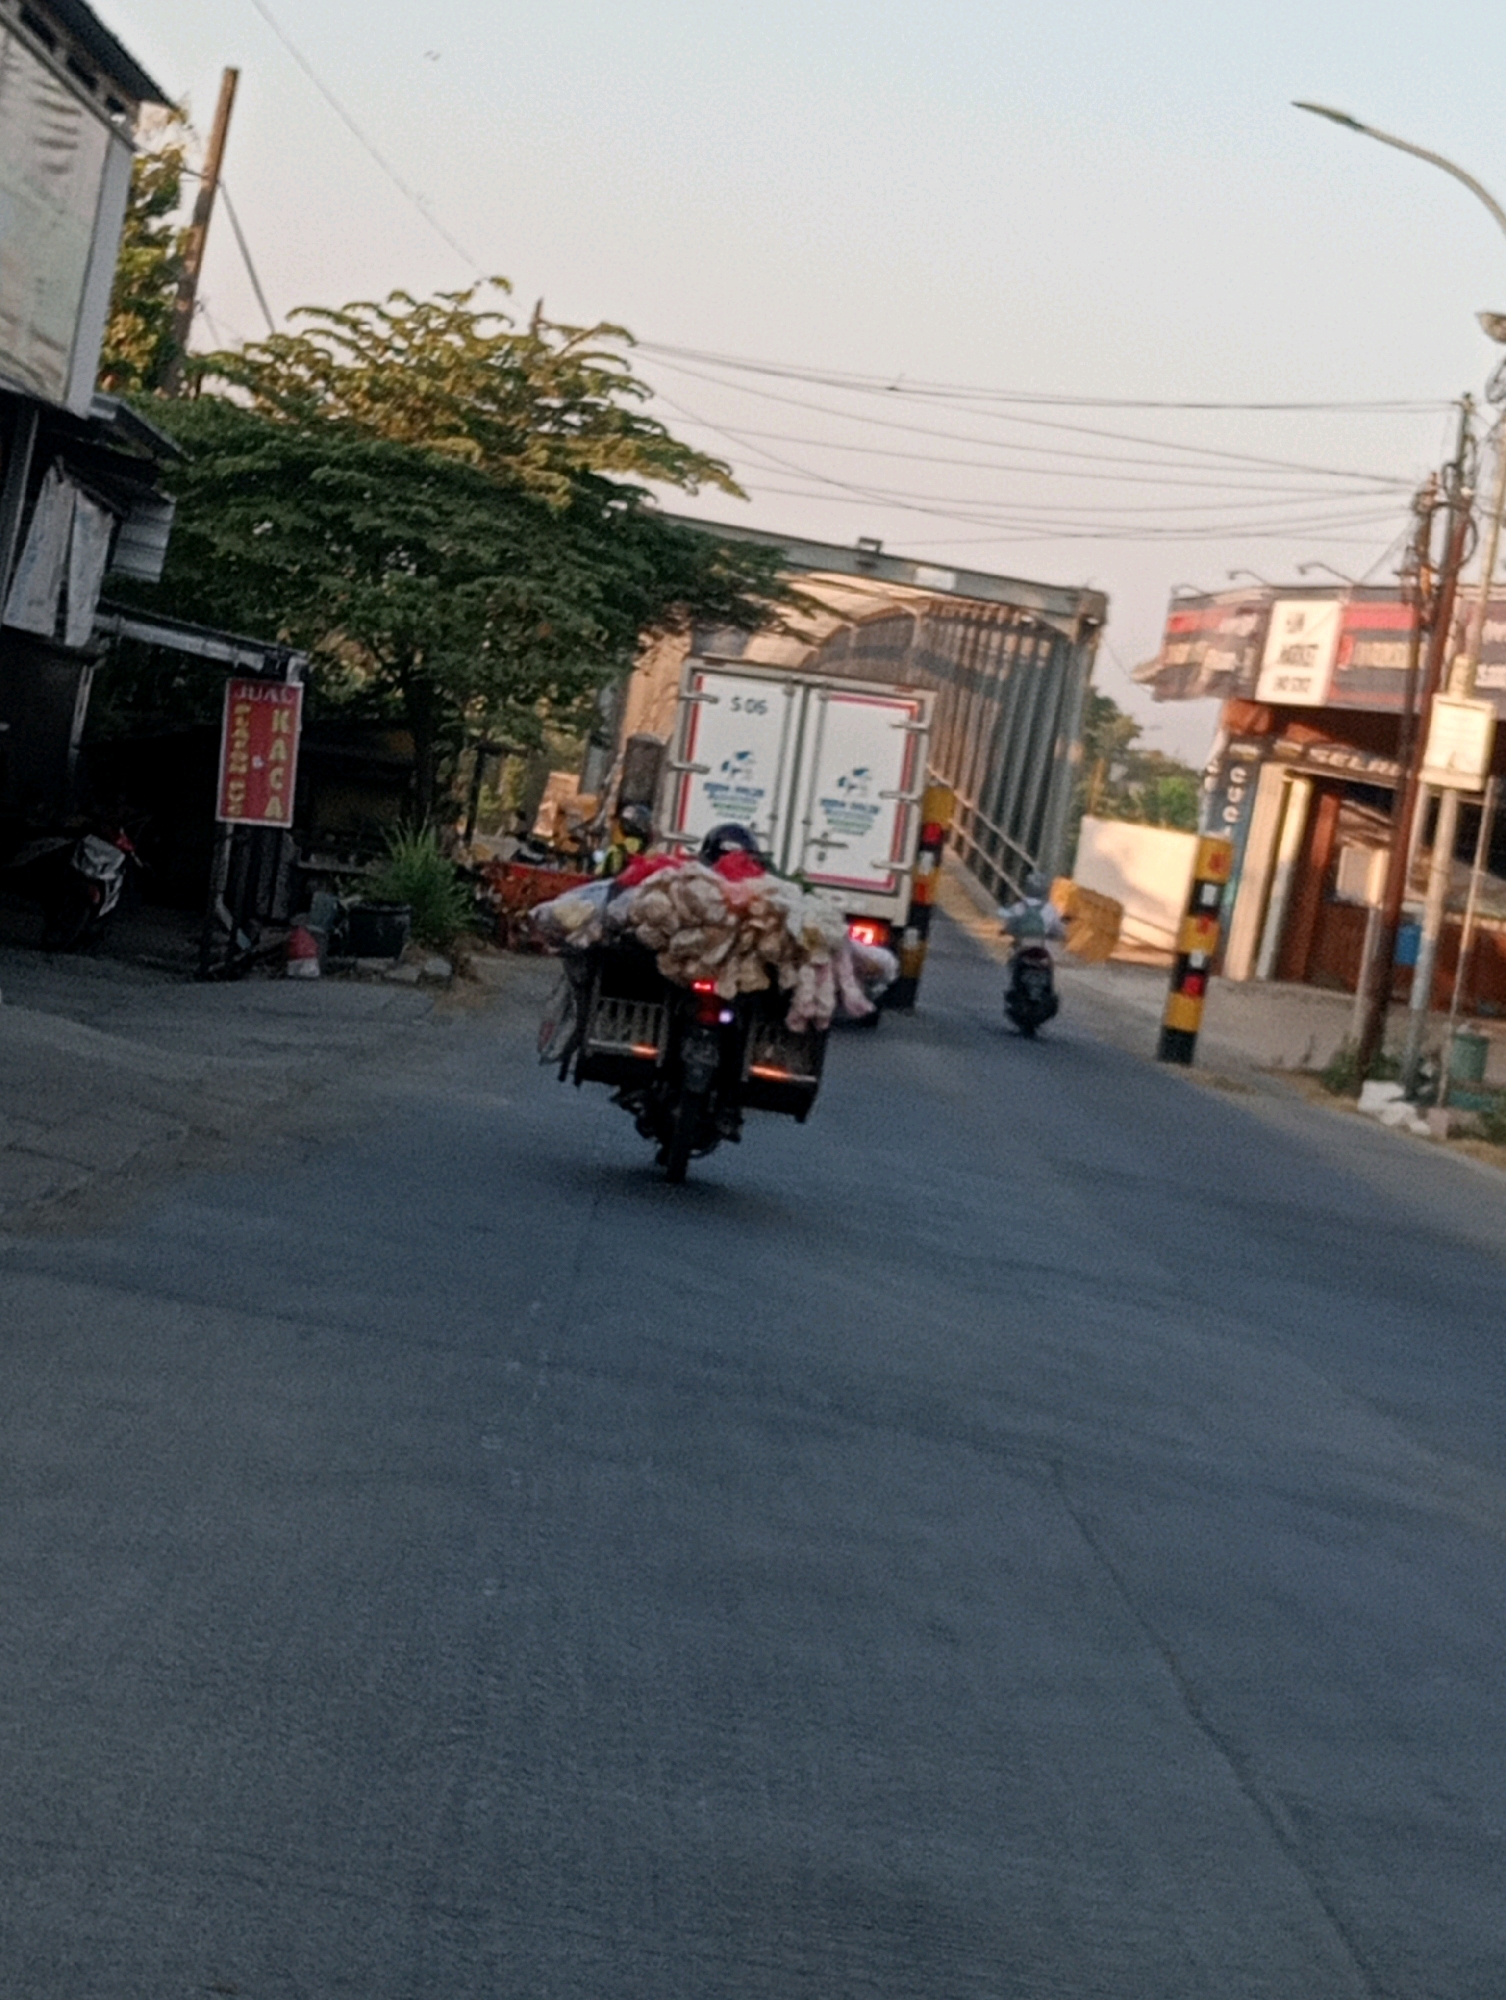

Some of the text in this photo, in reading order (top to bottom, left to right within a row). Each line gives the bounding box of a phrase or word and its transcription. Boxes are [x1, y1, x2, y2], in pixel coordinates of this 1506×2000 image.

[233, 685, 294, 704] JUAL
[730, 696, 742, 712] S
[264, 708, 291, 819] KACA
